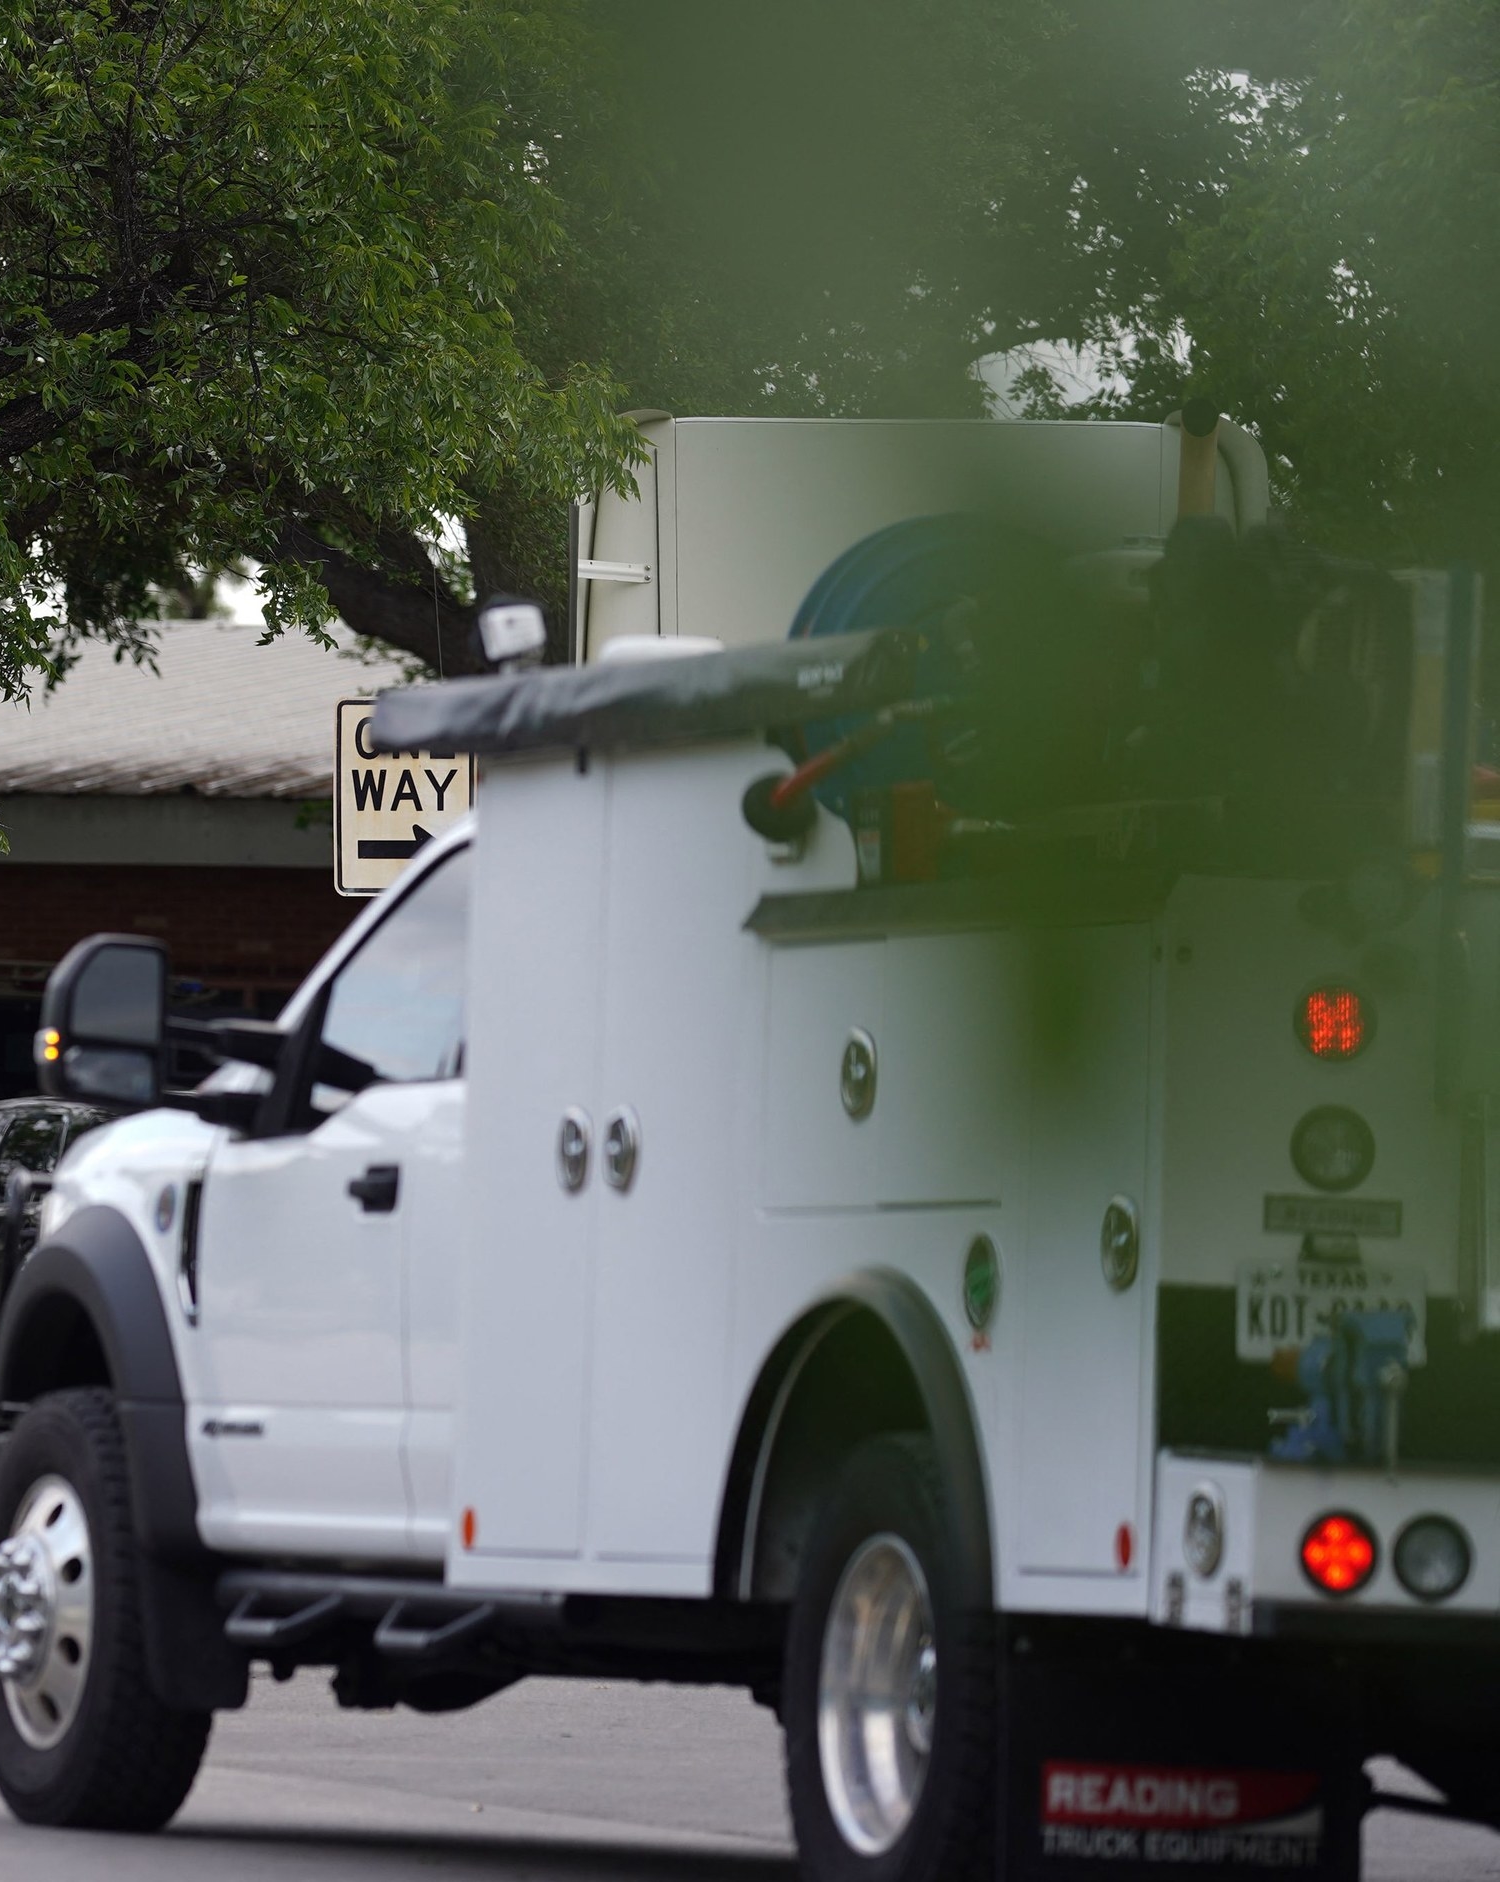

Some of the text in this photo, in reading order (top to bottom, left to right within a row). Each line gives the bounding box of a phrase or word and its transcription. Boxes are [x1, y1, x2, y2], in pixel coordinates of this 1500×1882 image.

[351, 769, 458, 812] WAY
[1049, 1772, 1239, 1818] READING
[1042, 1823, 1319, 1866] TRUCK EQUIPMENT
